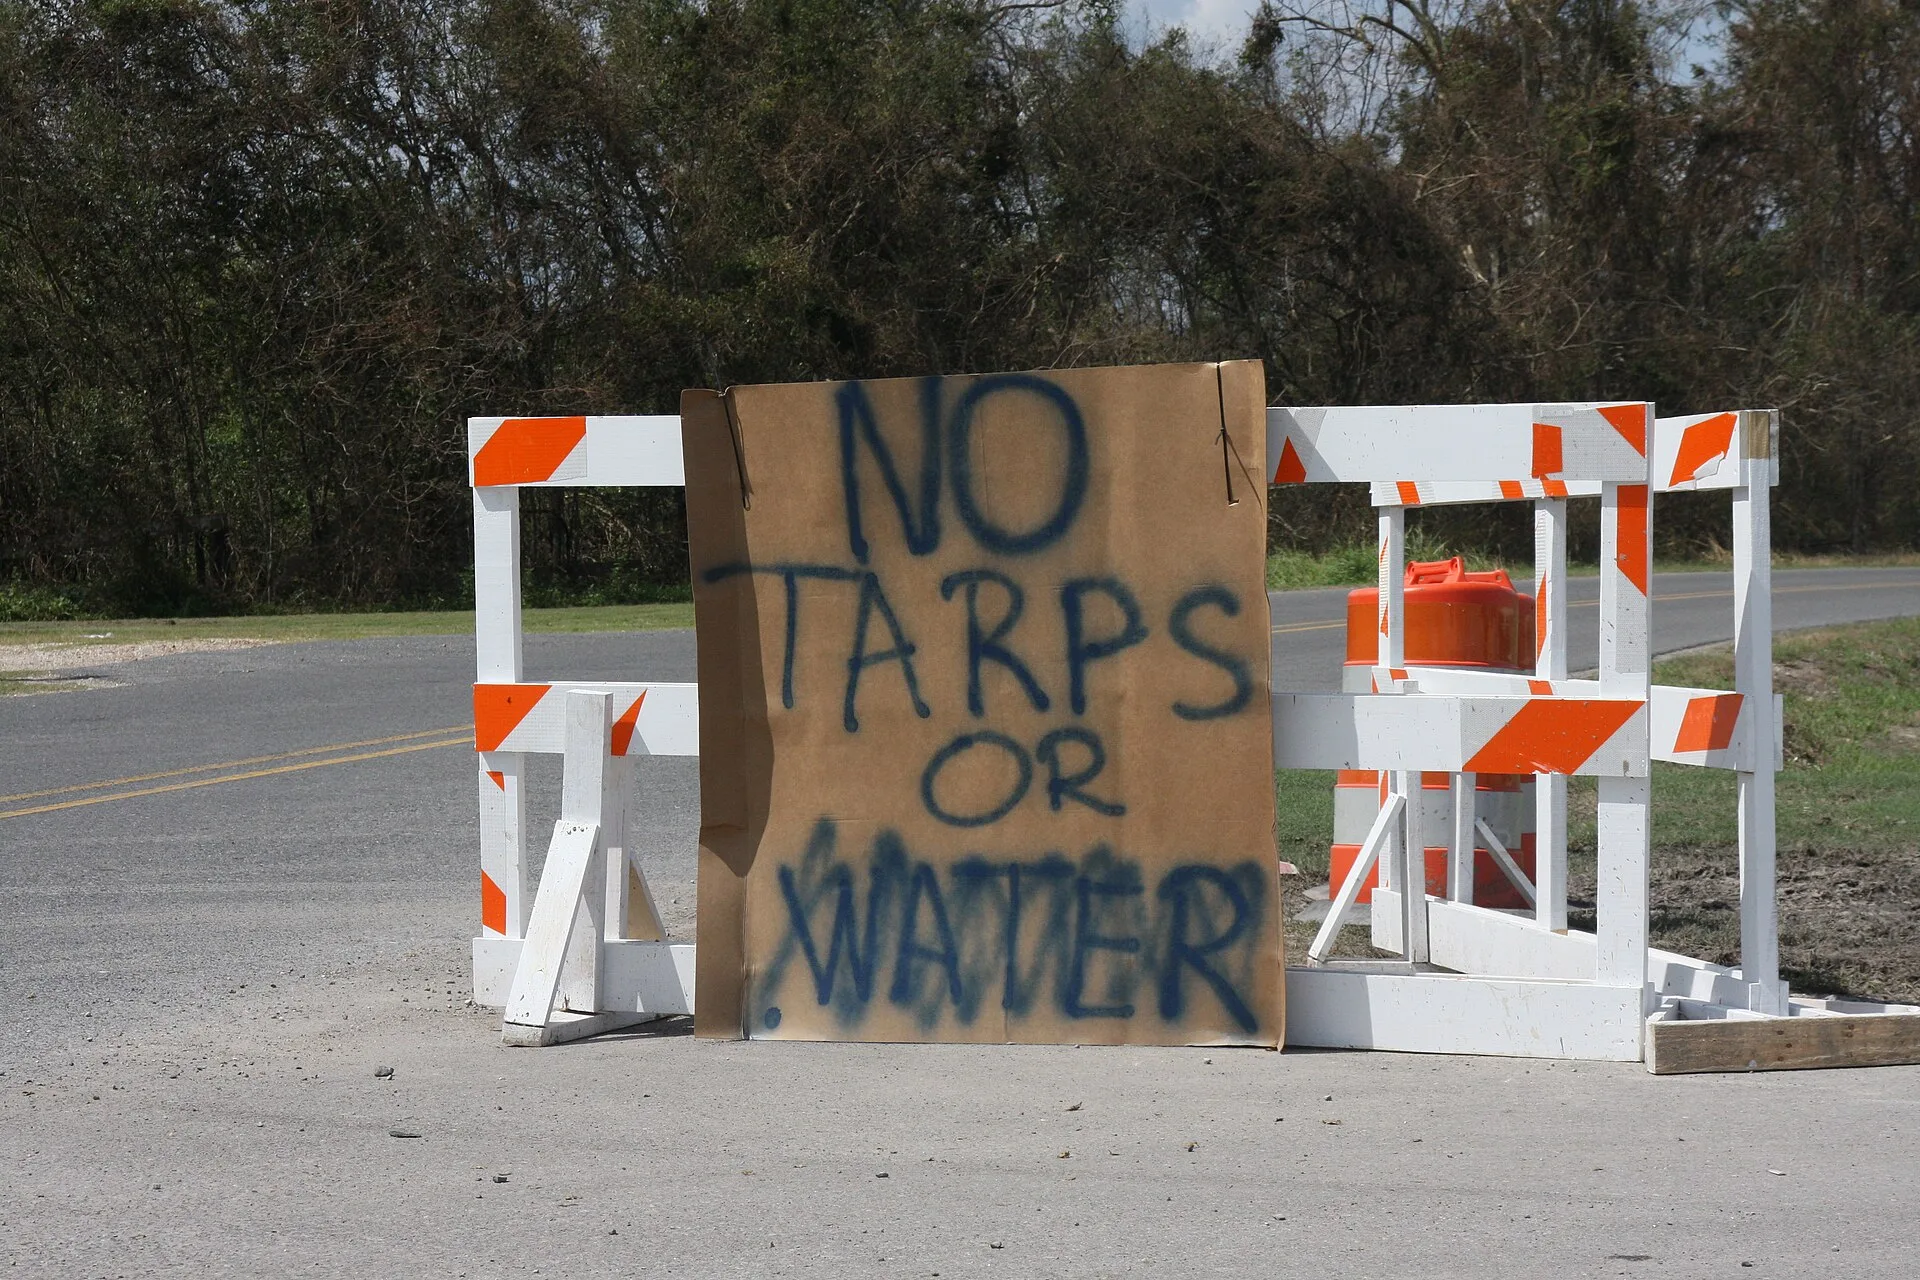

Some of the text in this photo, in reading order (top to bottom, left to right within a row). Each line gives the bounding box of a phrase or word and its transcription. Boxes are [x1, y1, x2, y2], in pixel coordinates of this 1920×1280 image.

[836, 374, 1090, 560] NO
[704, 564, 1254, 733] TARPS
[921, 726, 1127, 827] OR
[776, 860, 1260, 1034] WATER
